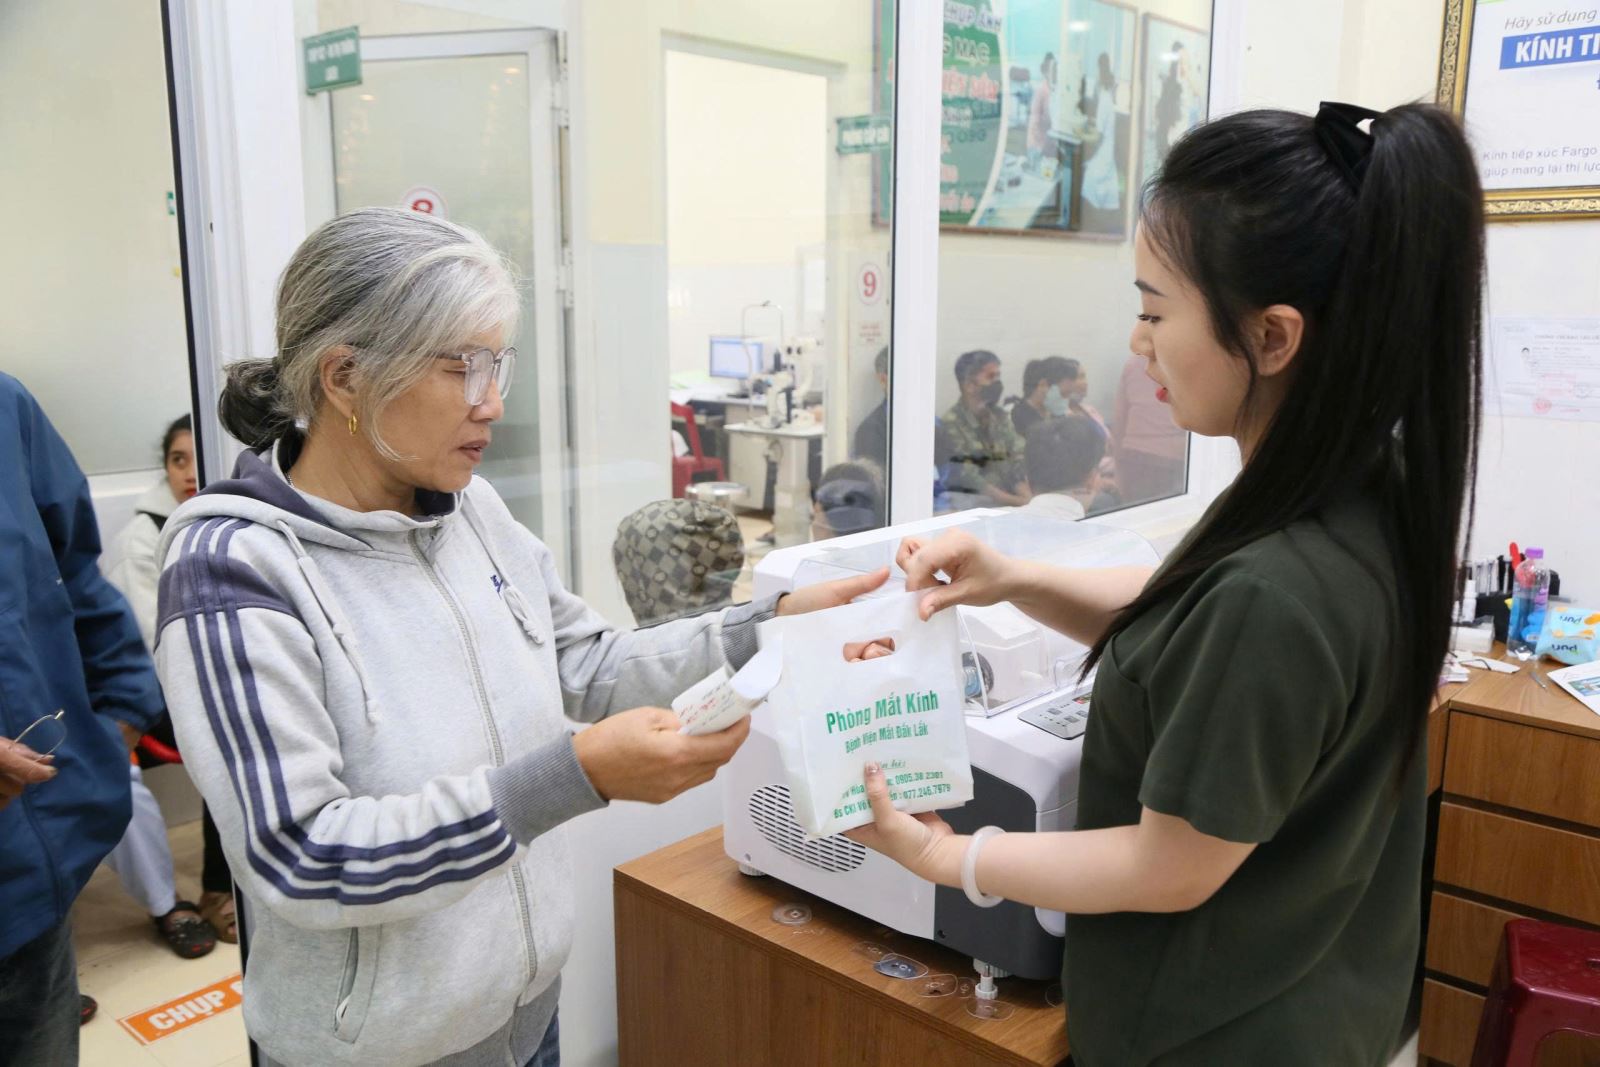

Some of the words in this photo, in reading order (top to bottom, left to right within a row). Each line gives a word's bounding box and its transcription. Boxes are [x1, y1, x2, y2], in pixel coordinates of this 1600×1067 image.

[1557, 10, 1597, 25] dụng
[1515, 36, 1574, 63] KÍNH
[1562, 146, 1598, 157] Fargo
[863, 271, 877, 297] 9
[826, 707, 871, 734] Phòng
[875, 692, 902, 719] Mắt
[906, 690, 939, 714] Kính
